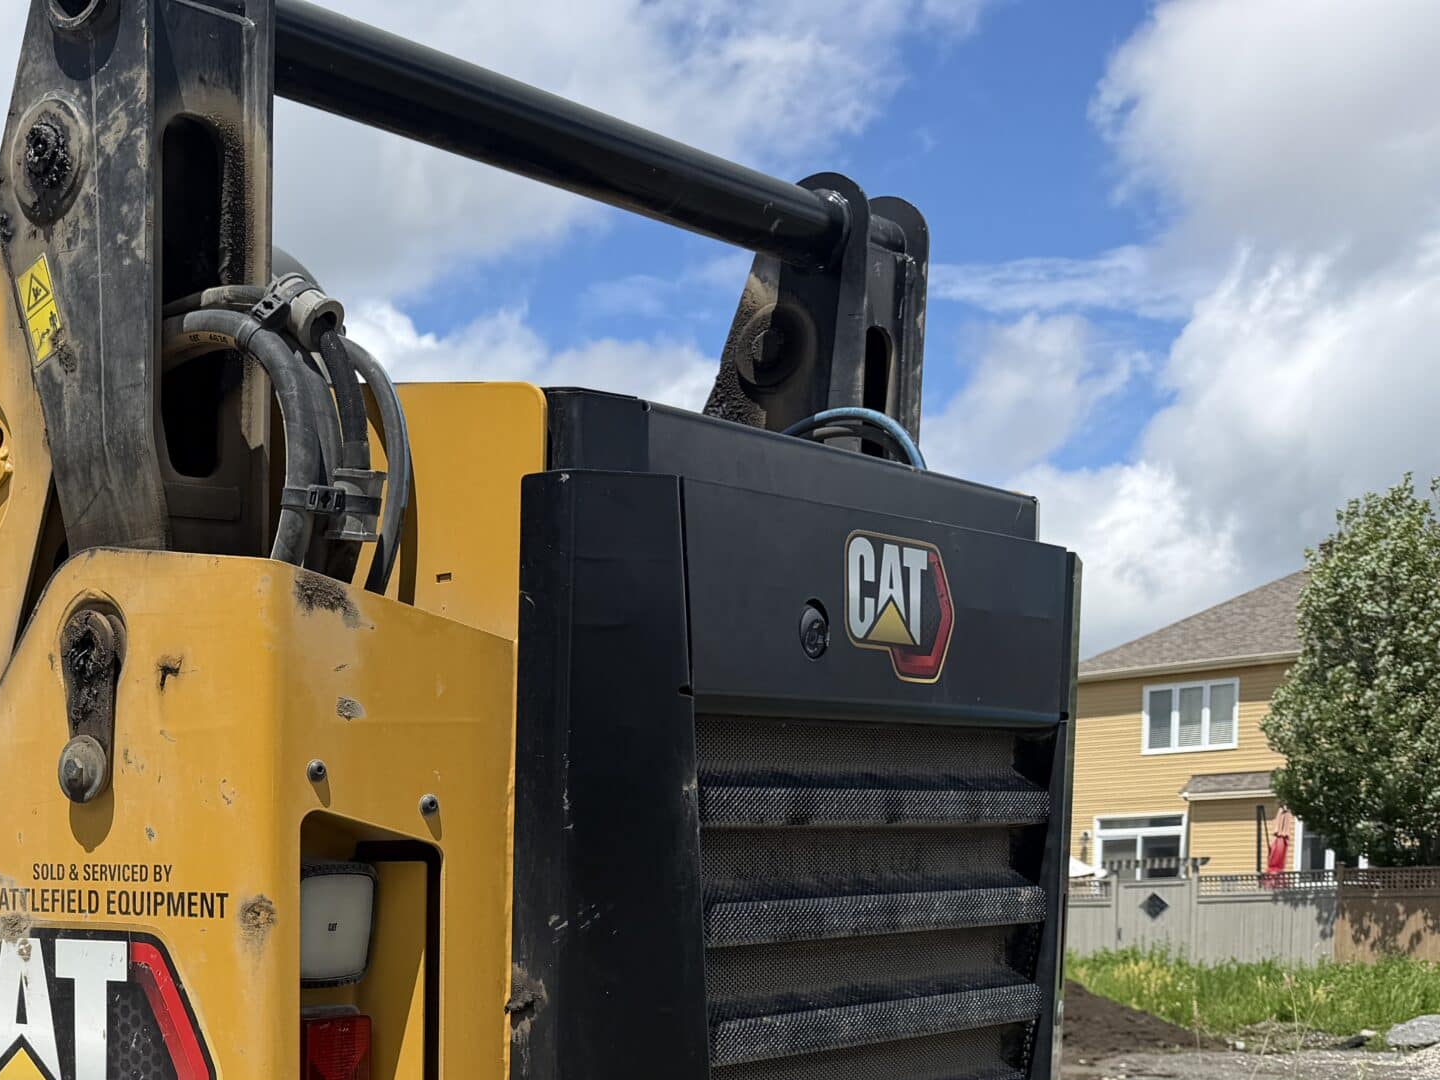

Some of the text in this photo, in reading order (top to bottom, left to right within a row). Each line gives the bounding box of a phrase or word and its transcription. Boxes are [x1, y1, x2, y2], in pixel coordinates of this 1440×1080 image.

[847, 536, 928, 646] CAT
[32, 863, 173, 883] SOLD & SERVICED BY
[106, 890, 229, 919] EQUIPMENT
